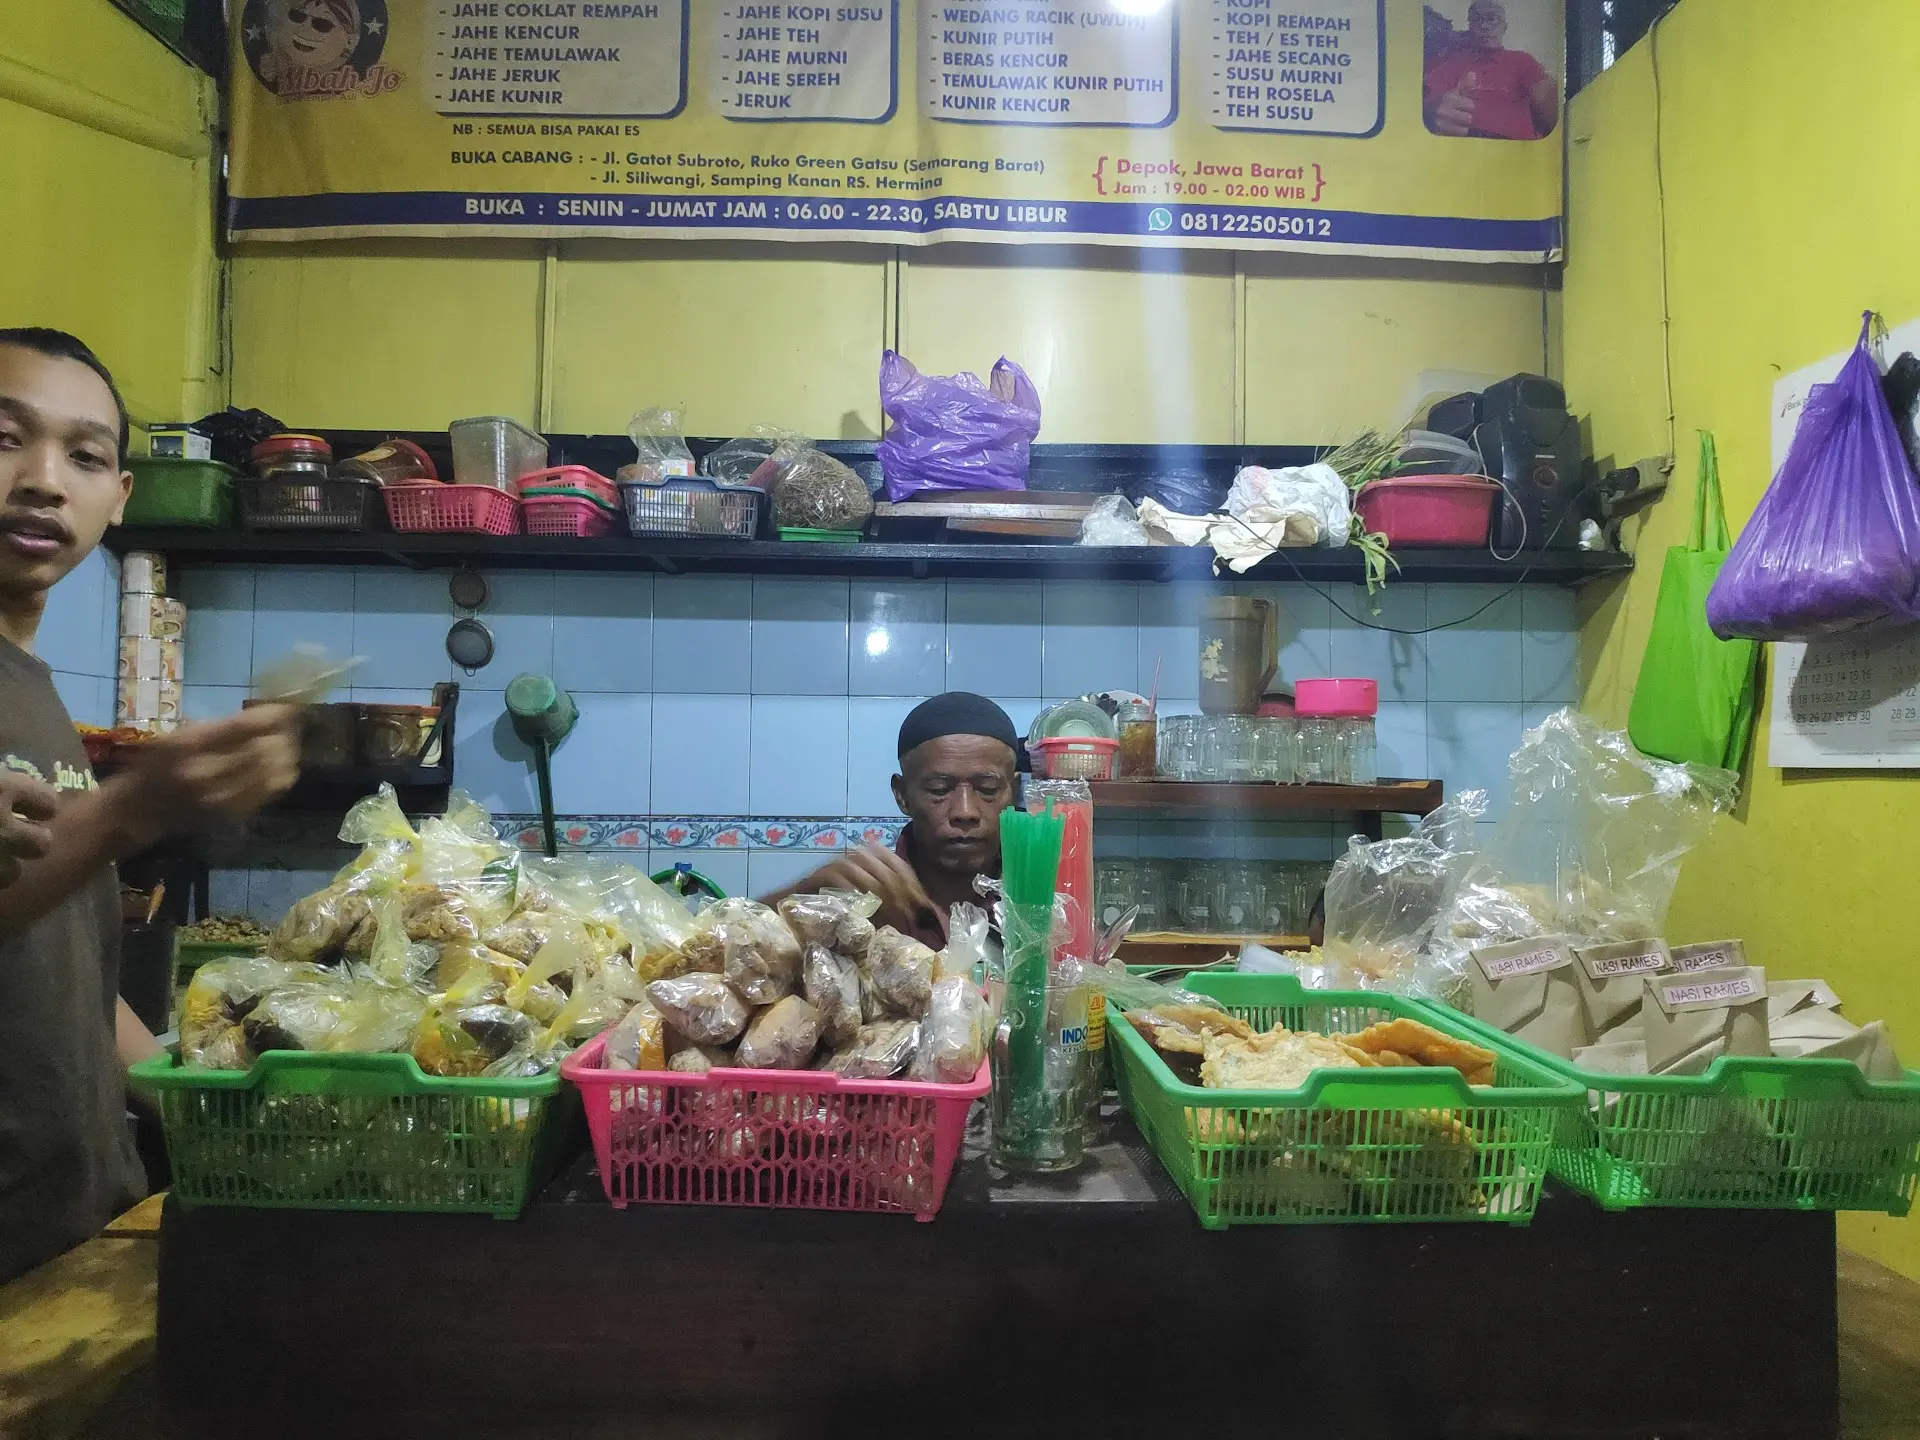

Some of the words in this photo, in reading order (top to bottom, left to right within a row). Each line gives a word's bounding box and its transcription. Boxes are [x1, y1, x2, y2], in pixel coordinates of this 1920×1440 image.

[451, 3, 498, 18] JAHE
[504, 3, 576, 18] COKLAT
[582, 3, 658, 18] REMPAH
[736, 5, 781, 20] JAHE
[787, 6, 830, 22] KOPI
[836, 7, 883, 22] SUSU
[943, 9, 1019, 24] WEDANG
[1026, 10, 1075, 25] RACIK
[1226, 12, 1270, 27] KOPI
[1277, 14, 1351, 31] REMPAH
[452, 25, 498, 40] JAHE
[504, 25, 580, 41] KENCUR
[736, 27, 781, 42] JAHE
[786, 28, 820, 43] TEH
[943, 30, 997, 45] KUNIR
[1003, 31, 1053, 45] PUTIH
[1226, 30, 1260, 45] TEH
[1280, 33, 1300, 47] ES
[1305, 34, 1339, 49] TEH
[450, 46, 497, 60] JAHE
[504, 47, 620, 62] TEMULAWAK
[735, 49, 781, 64] JAHE
[786, 50, 848, 66] MURNI
[943, 52, 994, 68] BERAS
[1000, 53, 1068, 68] KENCUR
[1226, 49, 1272, 64] JAHE
[1277, 51, 1352, 67] SECANG
[448, 67, 497, 82] JAHE
[502, 67, 561, 83] JERUK
[735, 71, 780, 86] JAHE
[786, 72, 841, 87] SEREH
[942, 74, 1048, 91] TEMULAWAK
[1053, 75, 1109, 92] KUNIR
[1113, 76, 1164, 93] PUTIH
[1226, 67, 1274, 82] SUSU
[1280, 68, 1343, 85] MURNI
[448, 88, 497, 103] JAHE
[502, 89, 563, 104] KUNIR
[734, 93, 792, 109] JERUK
[1226, 86, 1259, 101] TEH
[1266, 87, 1335, 103] ROSELA
[942, 96, 996, 111] KUNIR
[1002, 97, 1070, 113] KENCUR
[1226, 104, 1259, 119] TEH
[1266, 105, 1314, 121] SUSU
[453, 124, 474, 136] NB
[487, 124, 536, 136] SEMUA
[541, 124, 572, 137] BISA
[577, 124, 620, 137] PAKAI
[624, 124, 640, 137] ES
[451, 151, 497, 164] BUKA
[502, 151, 573, 165] CABANG
[603, 152, 620, 167] Jl.
[626, 153, 672, 168] Gatot
[677, 154, 746, 170] Subroto,
[751, 155, 790, 169] Ruko
[796, 155, 846, 170] Green
[852, 156, 898, 171] Gatsu
[904, 157, 989, 173] (Semarang
[995, 158, 1045, 175] Barat)
[1117, 159, 1187, 178] Depok,
[1193, 160, 1243, 178] Jawa
[1251, 162, 1304, 180] Barat
[603, 172, 620, 185] Jl.
[626, 172, 705, 189] Siliwangi,
[710, 174, 782, 190] Samping
[788, 175, 841, 188] Kanan
[847, 176, 870, 189] RS.
[876, 176, 943, 191] Hermina
[1113, 182, 1147, 196] Jam
[1164, 182, 1208, 197] 19.00
[1225, 183, 1269, 198] 02.00
[1274, 185, 1306, 200] WIB
[465, 199, 525, 216] BUKA
[557, 200, 624, 217] SENIN
[647, 201, 717, 219] JUMAT
[723, 203, 767, 220] JAM
[787, 204, 844, 221] 06.00
[866, 205, 929, 226] 22.30,
[933, 204, 999, 222] SABTU
[1007, 206, 1067, 224] LIBUR
[1180, 212, 1331, 237] 08122505012
[1906, 686, 1917, 697] 22
[1860, 710, 1871, 720] 30
[1890, 708, 1901, 719] 28
[1904, 708, 1916, 719] 29
[1490, 958, 1515, 975] NASI
[1515, 950, 1555, 970] RAMES
[1595, 959, 1620, 974] NASI
[1620, 954, 1660, 972] RAMES
[1683, 951, 1725, 972] RAMES
[1670, 986, 1701, 1002] NASI
[1703, 980, 1751, 999] RAMES
